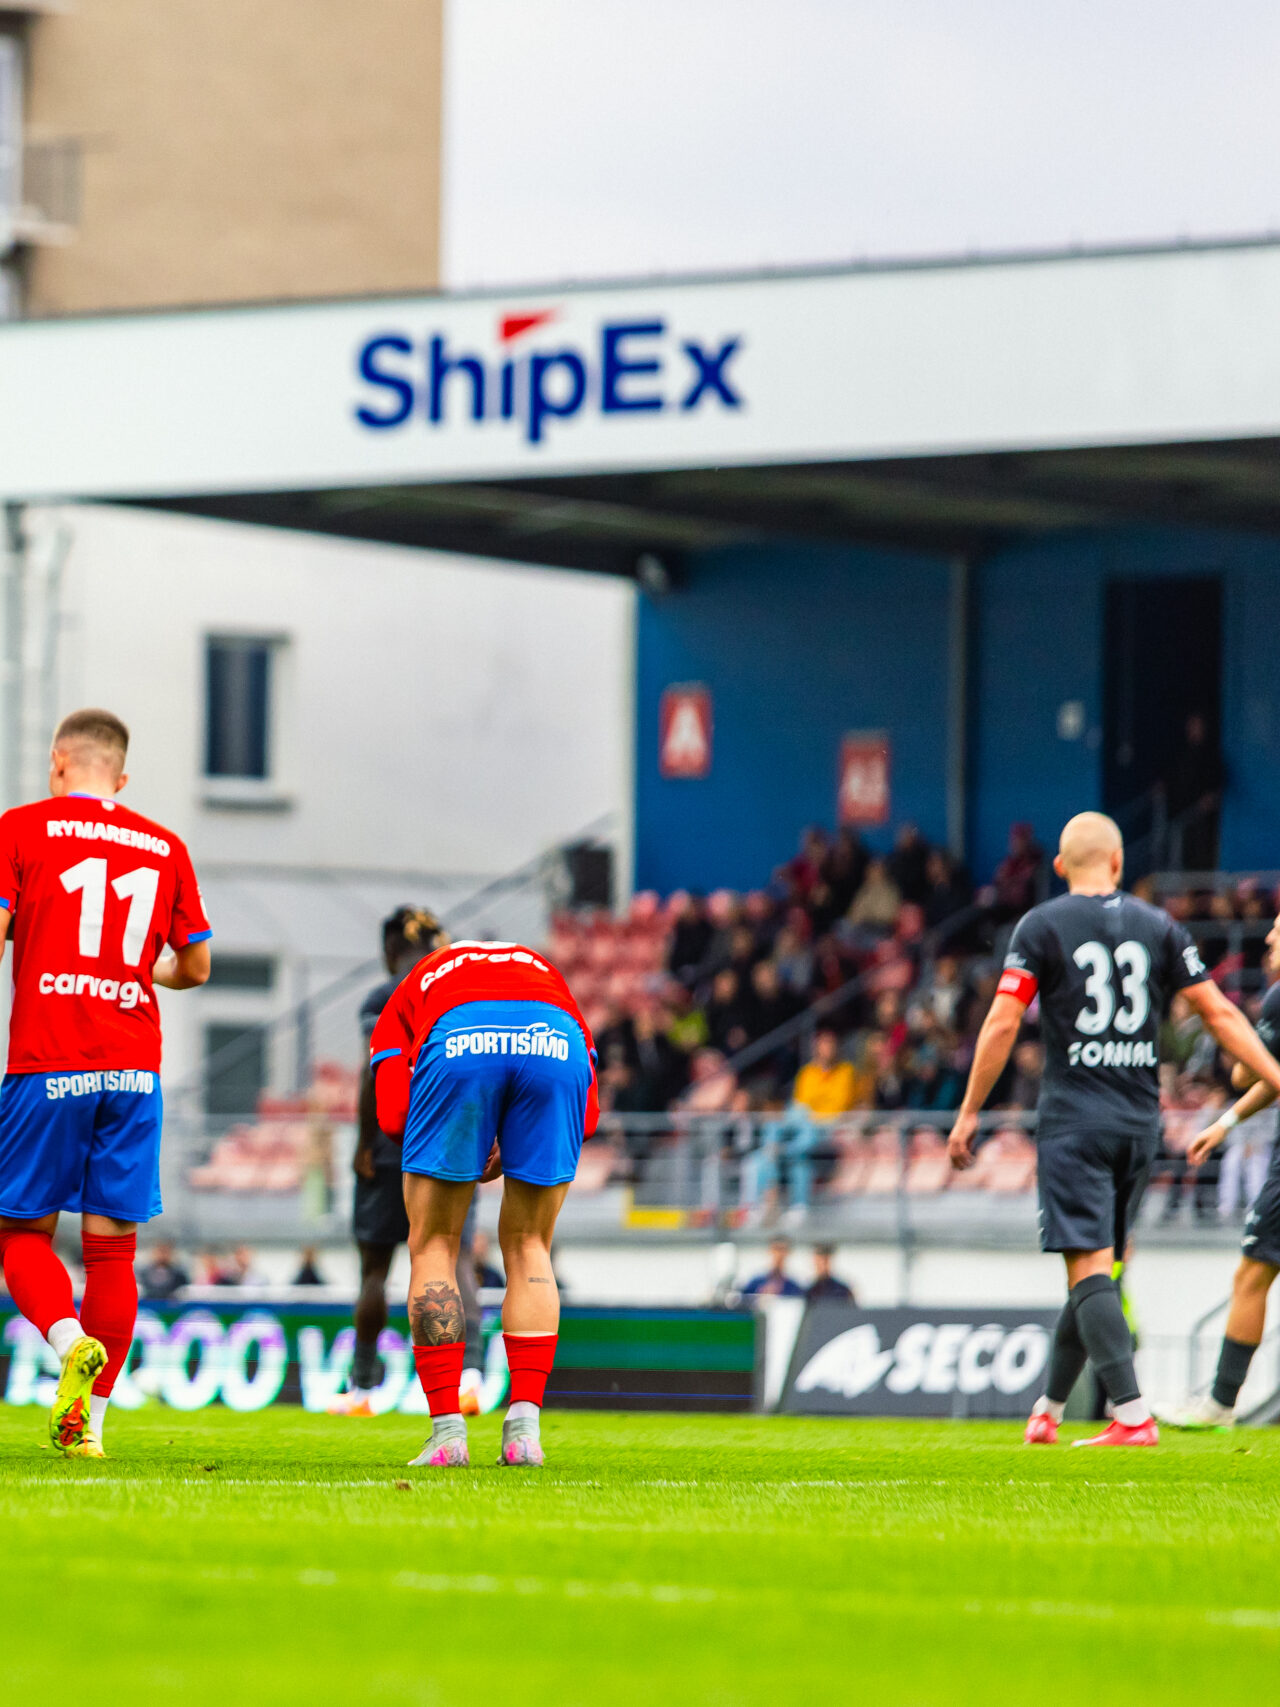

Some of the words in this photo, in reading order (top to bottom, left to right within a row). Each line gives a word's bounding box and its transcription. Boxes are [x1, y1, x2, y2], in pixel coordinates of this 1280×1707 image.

[356, 311, 743, 444] ShipEx
[663, 698, 708, 762] A
[46, 819, 171, 857] RYMARENKO
[59, 857, 160, 967] 11
[1072, 940, 1152, 1035] 33
[445, 1031, 570, 1061] SPORTISIMO
[45, 1070, 154, 1100] SPORTISIMO
[884, 1323, 1051, 1394] SECO
